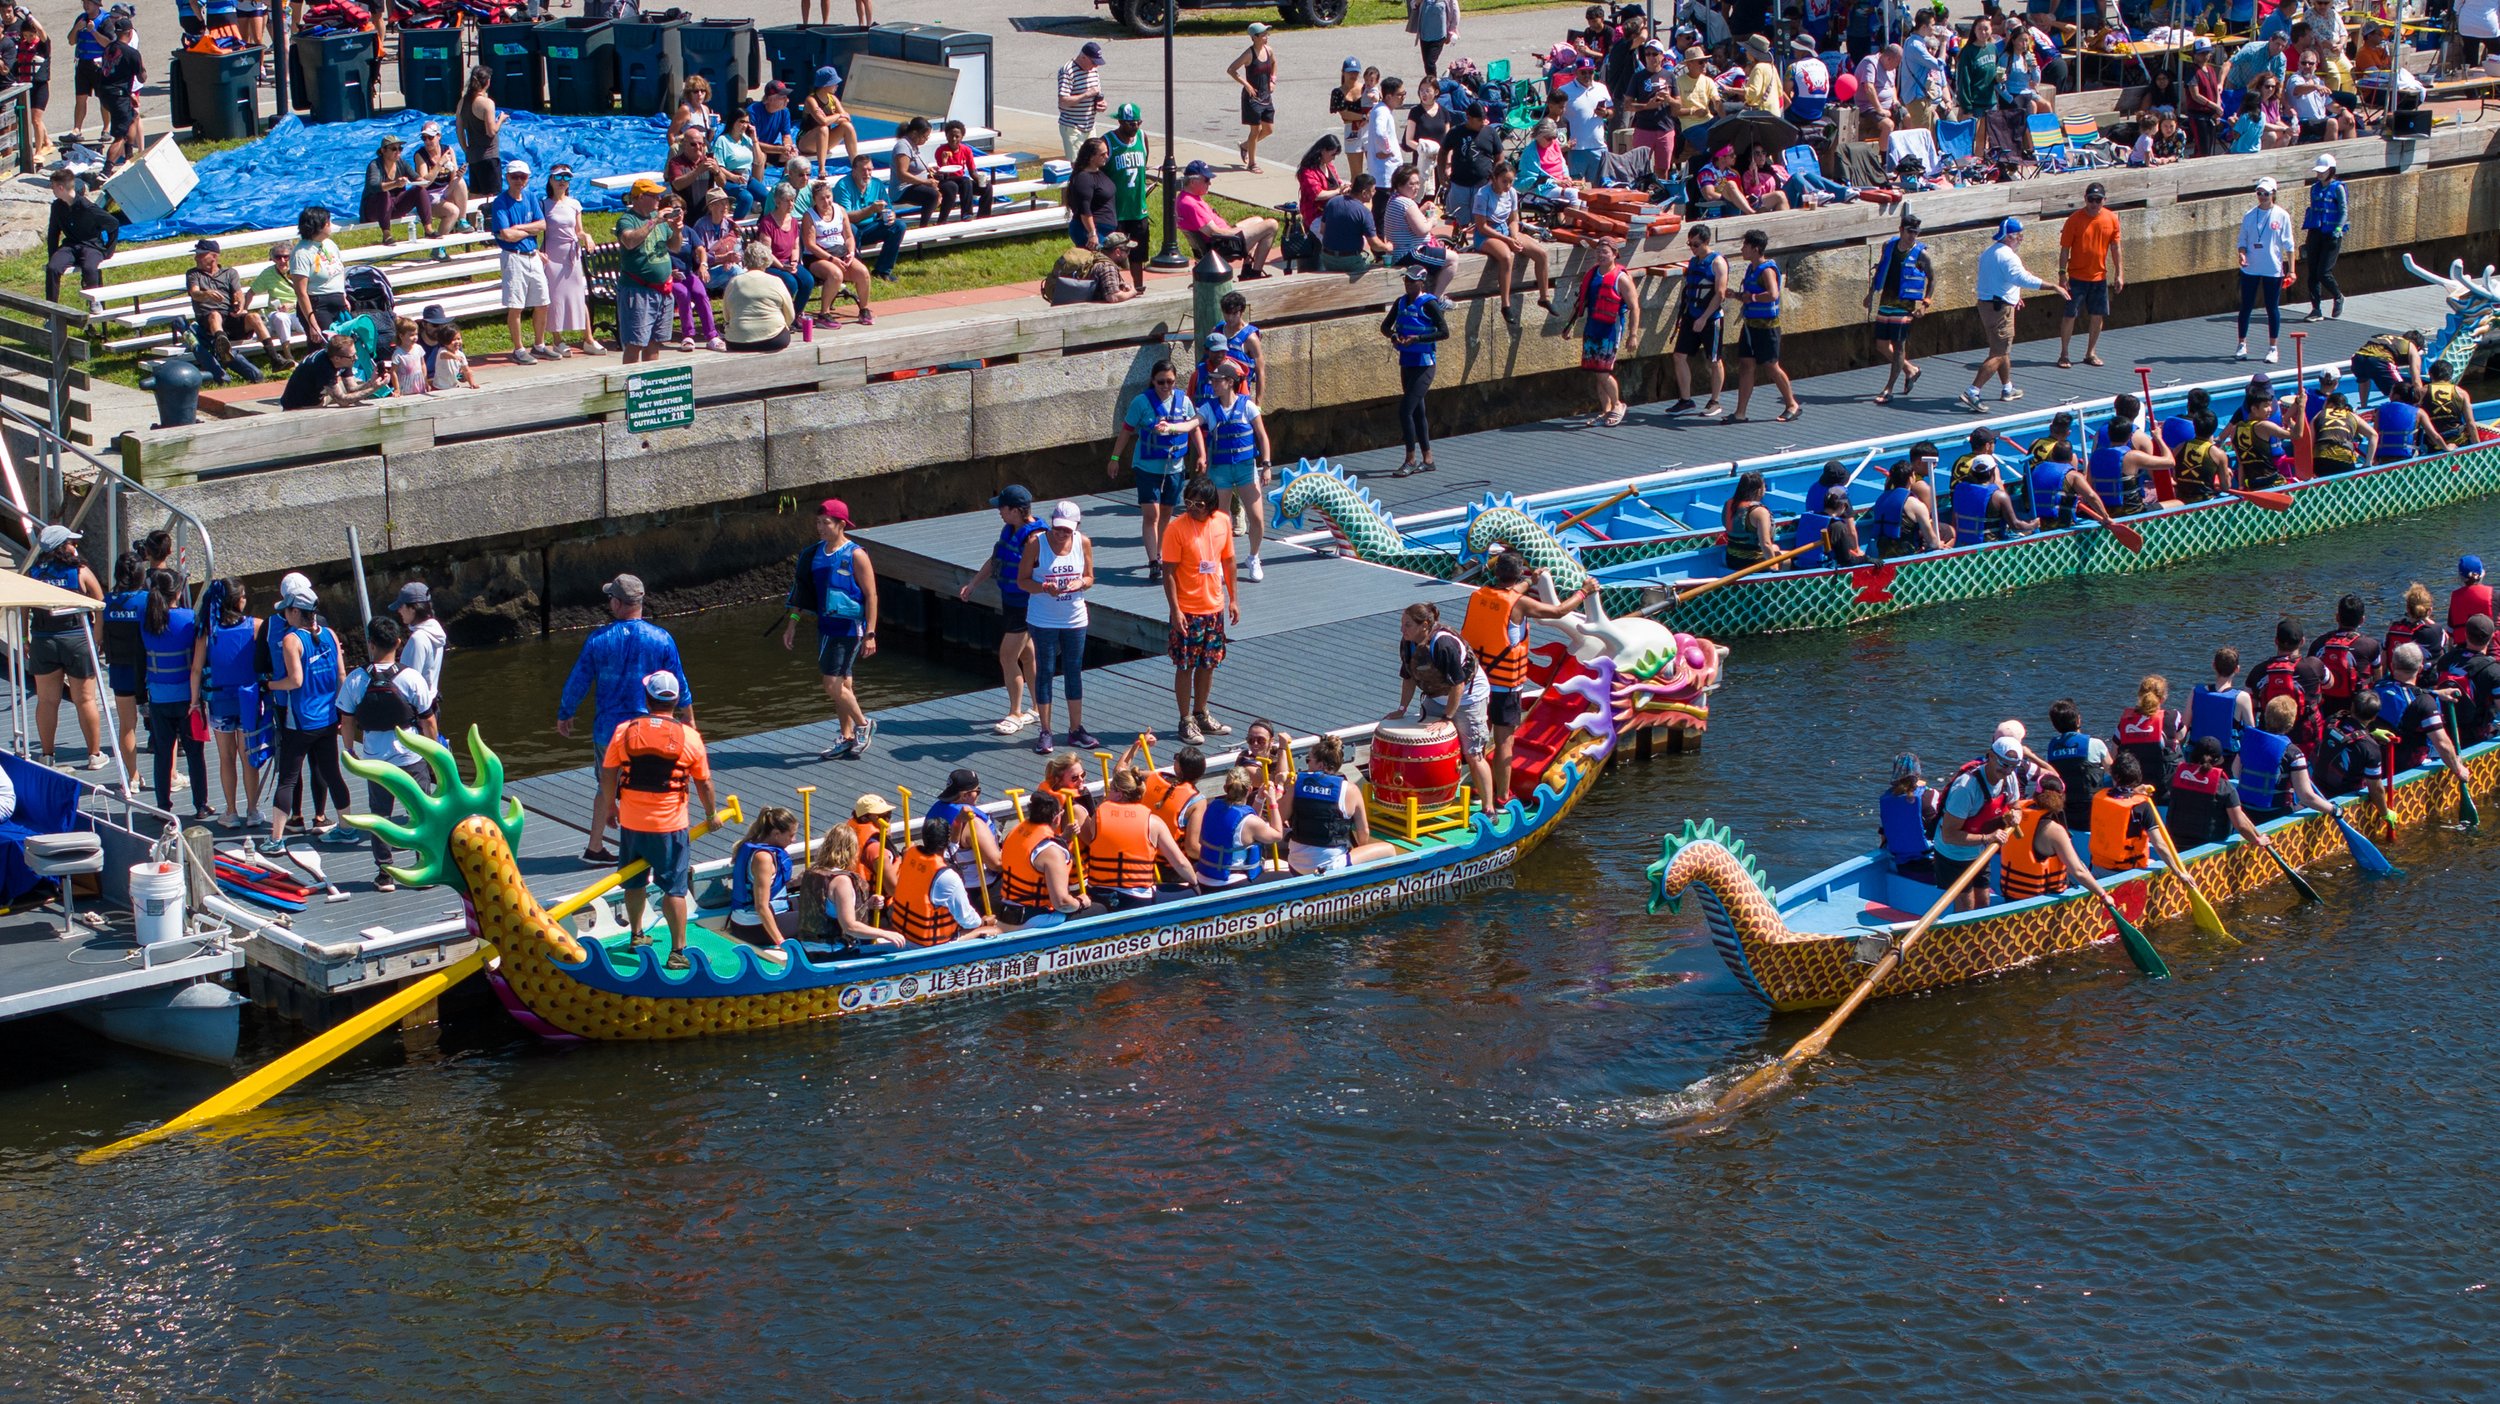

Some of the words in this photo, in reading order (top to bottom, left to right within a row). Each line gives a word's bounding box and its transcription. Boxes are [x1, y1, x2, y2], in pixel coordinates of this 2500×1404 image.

[1115, 151, 1145, 170] BOSTON
[1126, 168, 1138, 188] 7
[641, 373, 692, 387] Narragansett
[629, 391, 644, 399] Bay
[645, 383, 692, 396] Commission
[638, 401, 653, 409] WET
[653, 396, 683, 407] WEATHER
[630, 410, 656, 420] SEWAGE
[657, 403, 693, 415] DISCHARGE
[633, 417, 662, 428] OUTFALL
[1052, 565, 1074, 574] CFSD
[1047, 934, 1151, 970] Taiwanese
[1157, 914, 1258, 947] Chambers
[1264, 906, 1284, 925] of
[1289, 885, 1391, 920] Commerce
[1397, 869, 1446, 896] North
[1450, 848, 1516, 882] America
[927, 955, 1040, 993] 北美台灣商會
